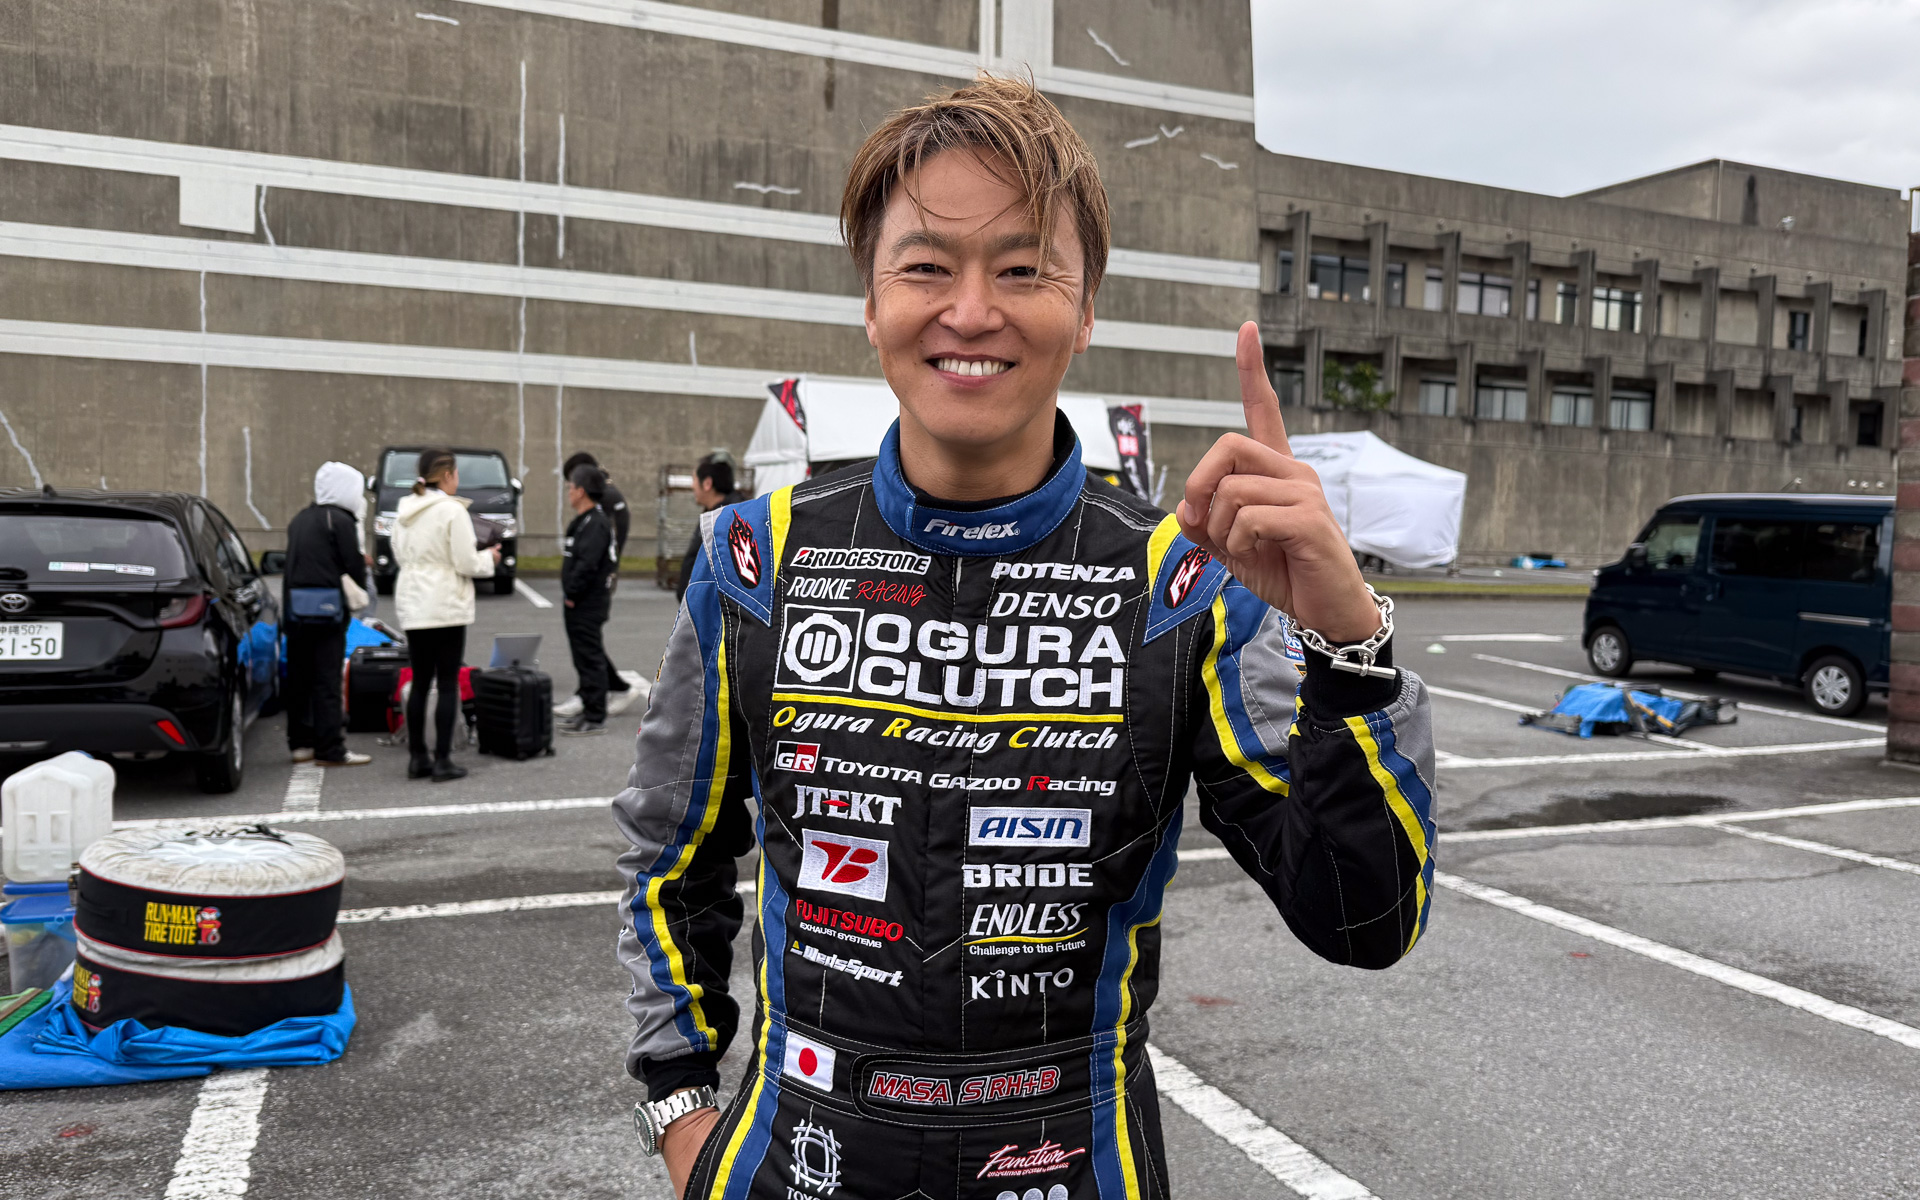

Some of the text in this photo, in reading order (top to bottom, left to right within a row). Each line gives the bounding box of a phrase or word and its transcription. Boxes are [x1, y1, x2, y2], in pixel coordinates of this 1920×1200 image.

[791, 548, 931, 575] BRIDGESTONE
[990, 561, 1136, 583] POTENZA
[787, 576, 927, 607] ROOKIE RACING
[989, 593, 1121, 619] DENSO
[864, 612, 1126, 664] OGURA
[858, 656, 1124, 708] CLUTCH
[773, 706, 1119, 754] Ogura Racing Clutch
[777, 751, 1118, 797] GR TOYOTA GAZOO Racing
[792, 784, 902, 826] JTEKT
[977, 816, 1083, 840] AISIN
[961, 862, 1094, 888] BRIDE
[144, 921, 197, 945] TIRE TOTE
[796, 899, 904, 942] FUJITSUBO
[967, 902, 1089, 936] ENDLESS
[800, 922, 882, 949] EXHAUST SYSTEMS
[969, 939, 1086, 956] Challenge to the Future
[802, 945, 904, 987] WedsSport
[870, 1073, 952, 1104] MASA
[976, 1140, 1086, 1179] Function
